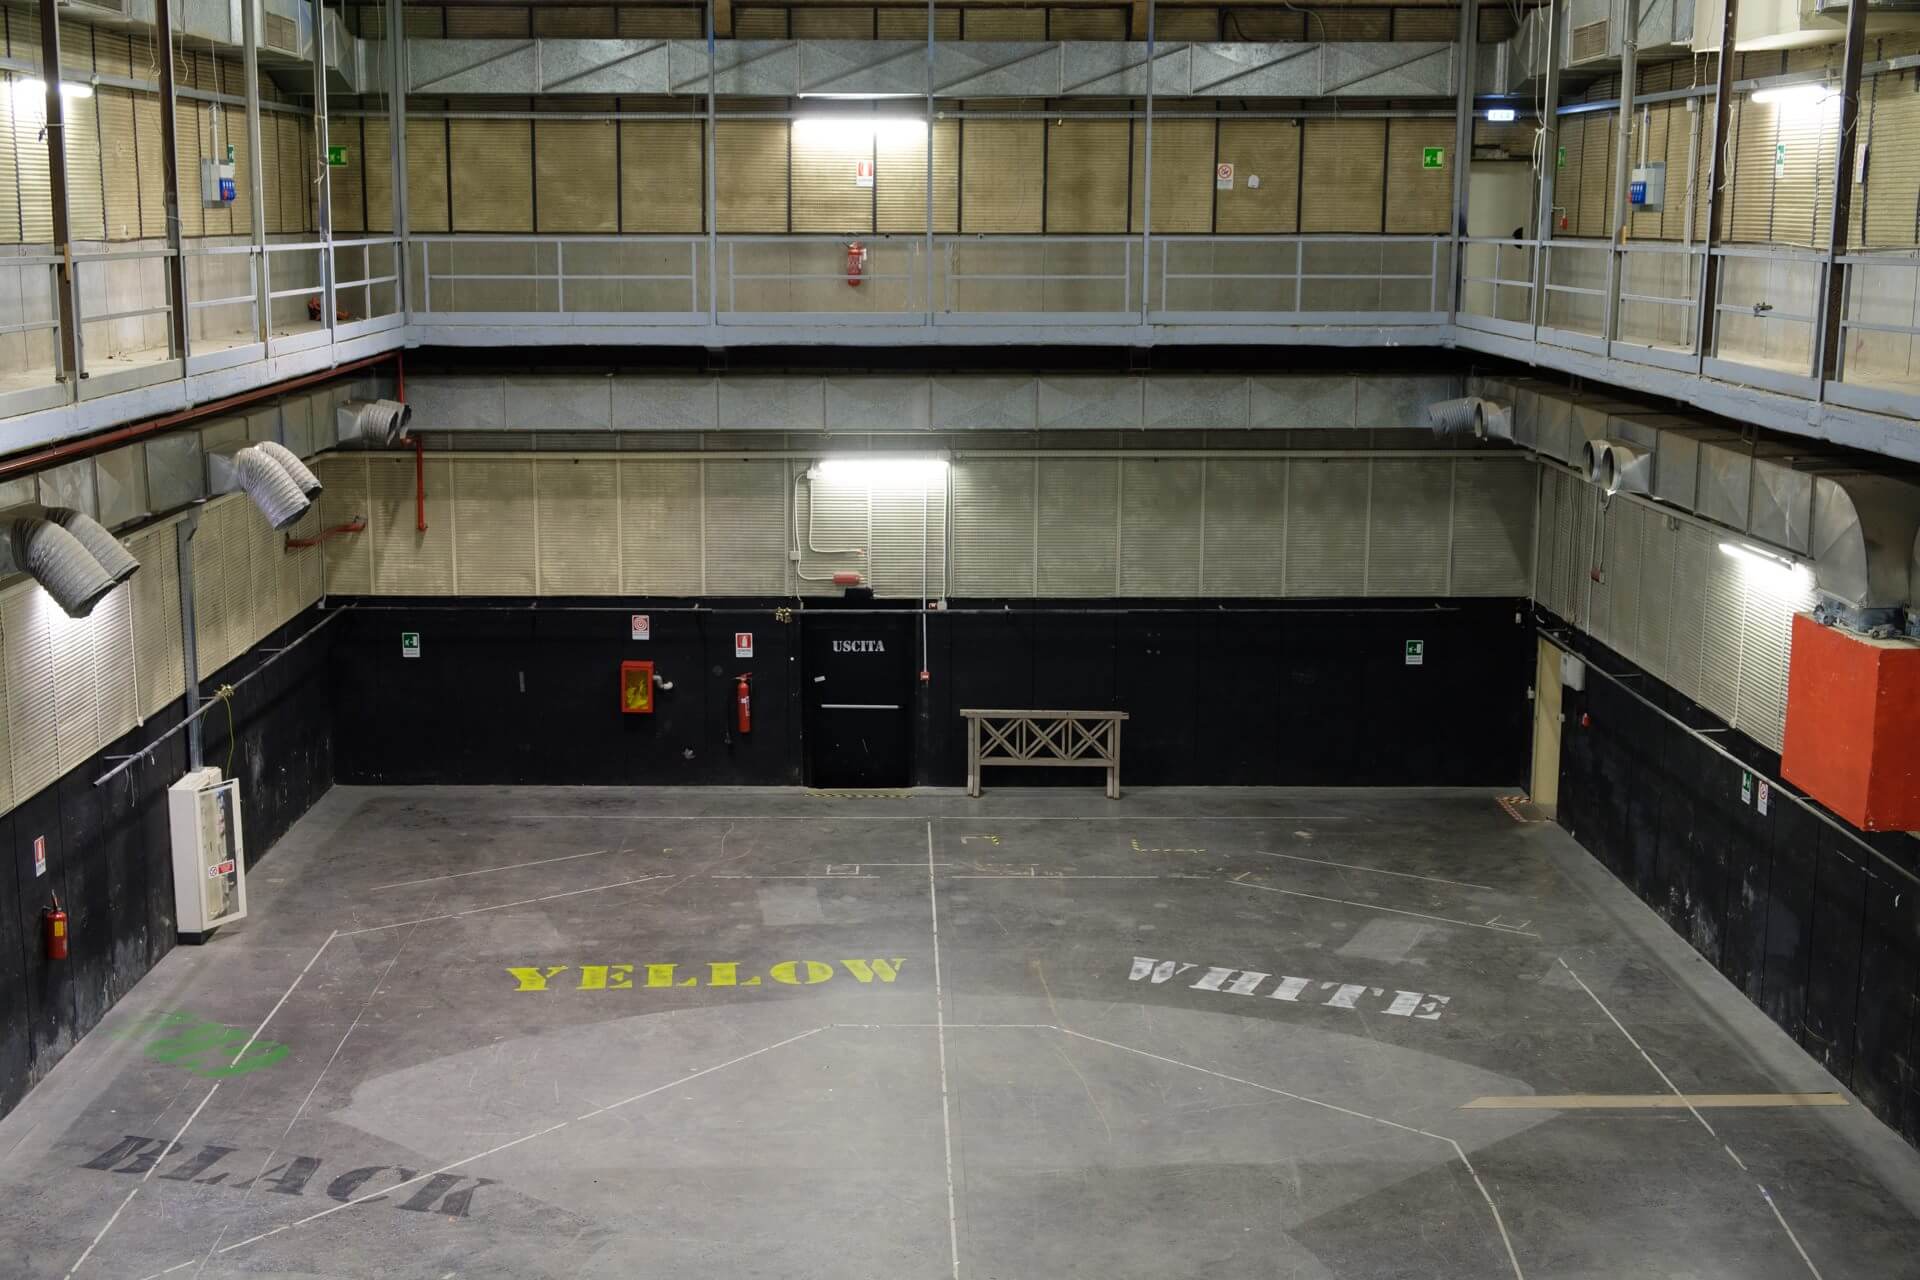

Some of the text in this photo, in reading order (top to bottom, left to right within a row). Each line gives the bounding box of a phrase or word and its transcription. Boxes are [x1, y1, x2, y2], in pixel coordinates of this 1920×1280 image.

[833, 640, 885, 653] USCITA
[507, 959, 905, 992] YELLOW
[1129, 957, 1451, 1021] WHITE
[80, 1136, 496, 1218] BLACK
